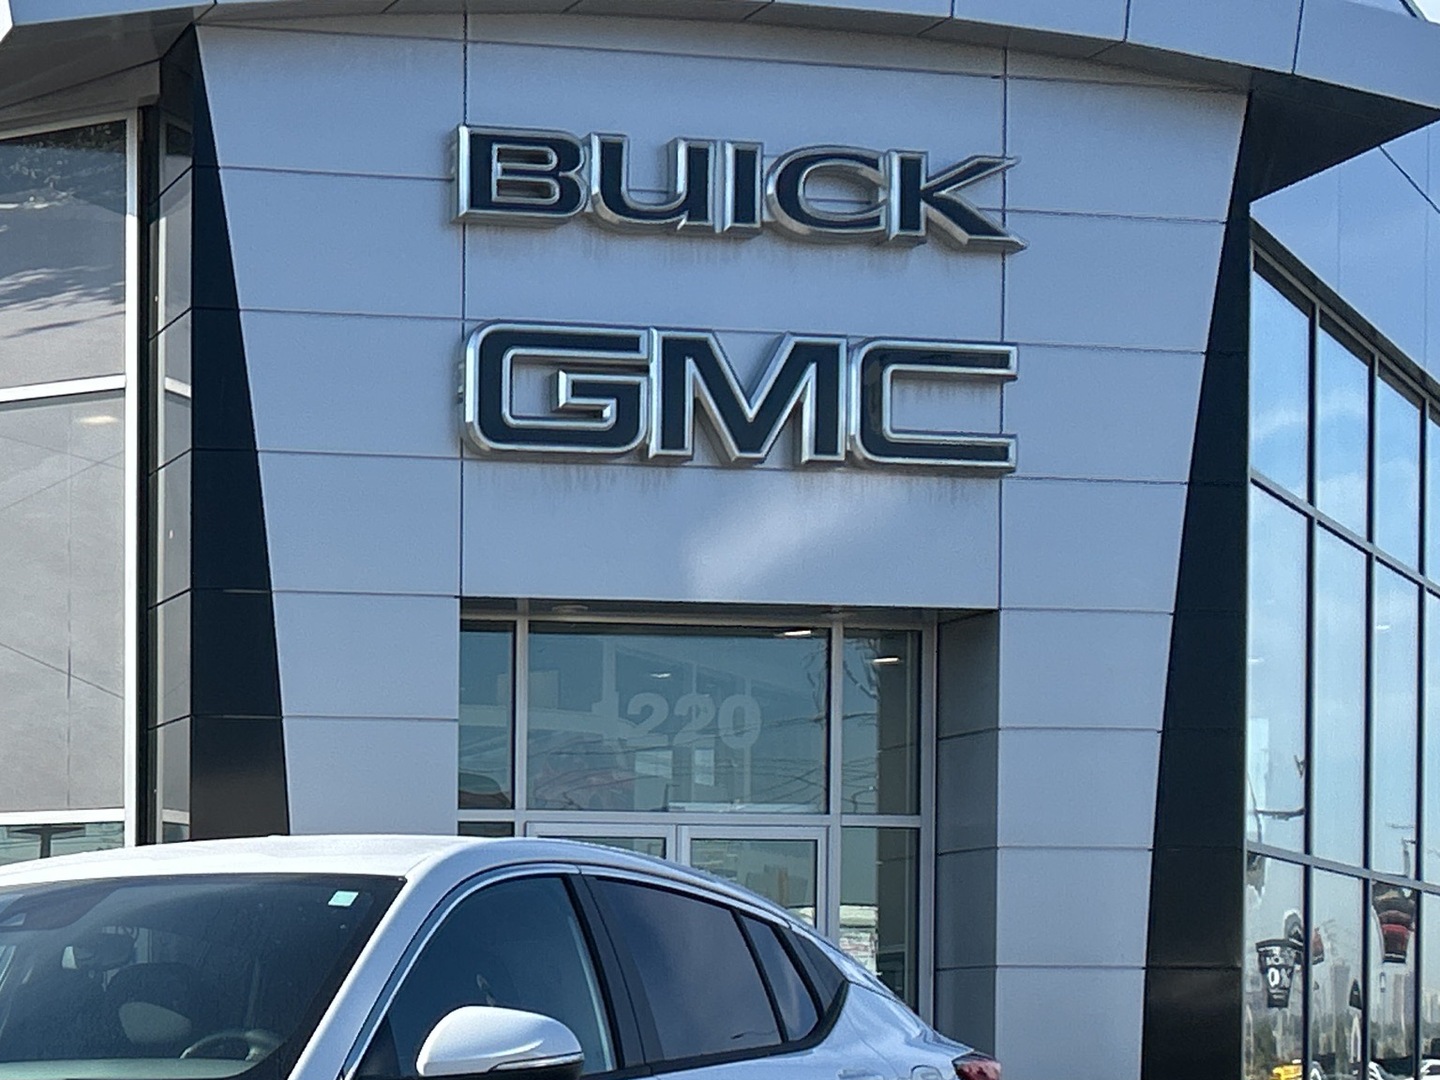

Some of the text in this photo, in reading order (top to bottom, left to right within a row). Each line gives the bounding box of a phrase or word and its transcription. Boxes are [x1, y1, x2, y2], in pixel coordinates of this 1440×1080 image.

[451, 125, 1028, 254] BUICK
[464, 319, 1019, 473] GMC
[627, 692, 761, 750] 220
